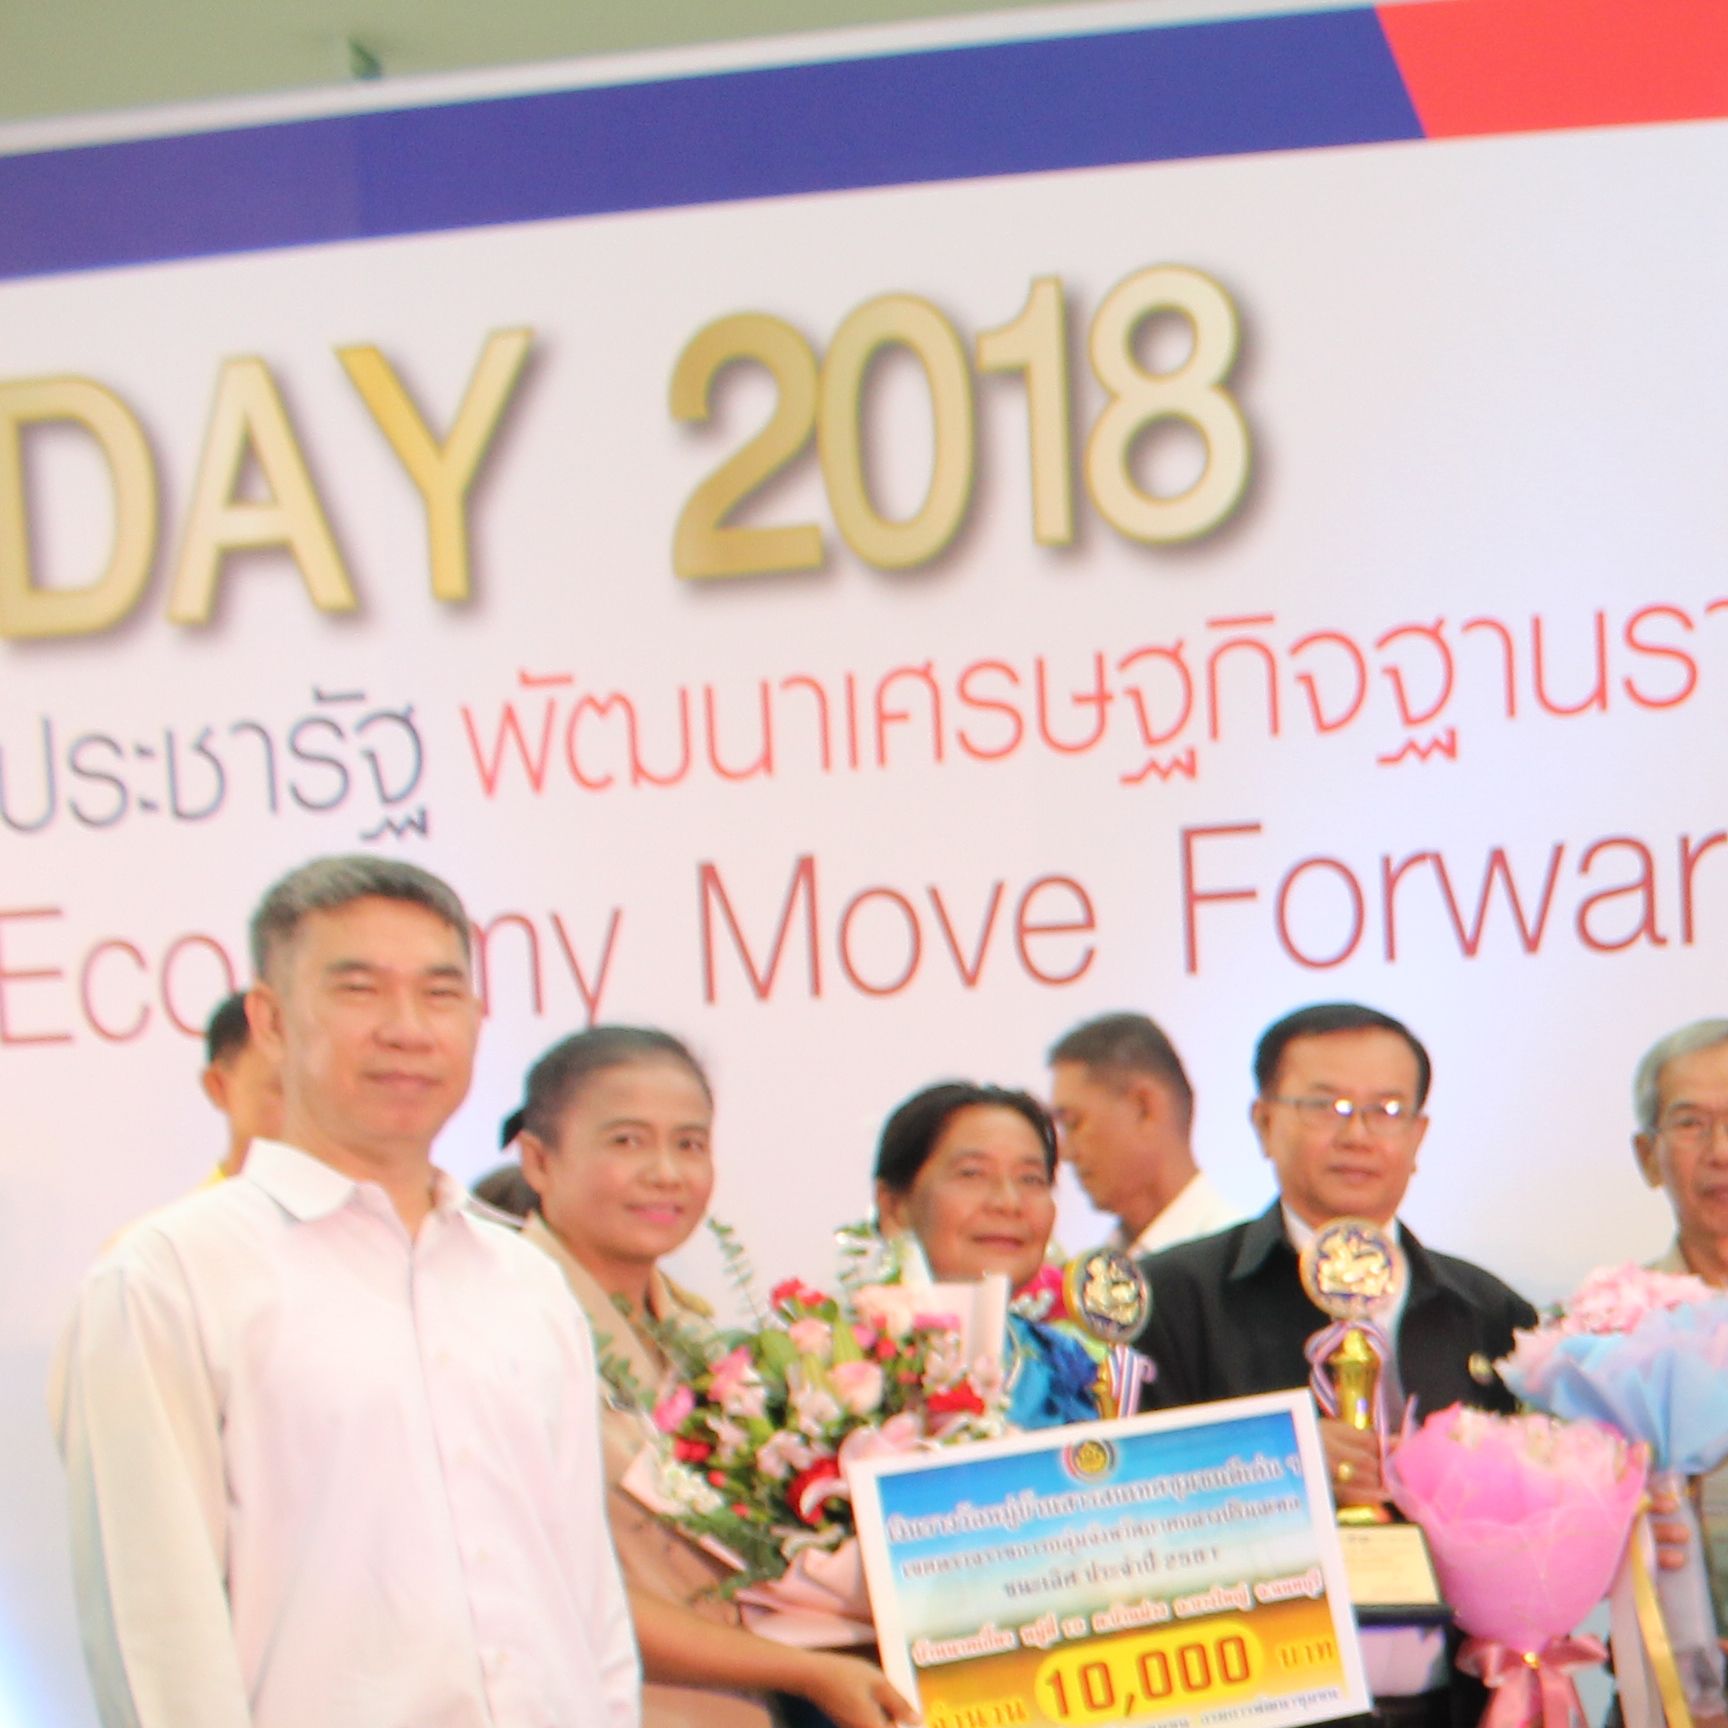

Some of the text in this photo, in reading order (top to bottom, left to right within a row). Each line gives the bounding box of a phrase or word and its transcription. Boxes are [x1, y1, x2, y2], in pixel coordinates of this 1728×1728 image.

[0, 262, 1252, 642] DAY 2018
[0, 684, 430, 842] ประชารัฐ
[0, 906, 622, 1046] Ecomy
[698, 853, 1097, 1008] Move
[1044, 1634, 1251, 1718] 10,000
